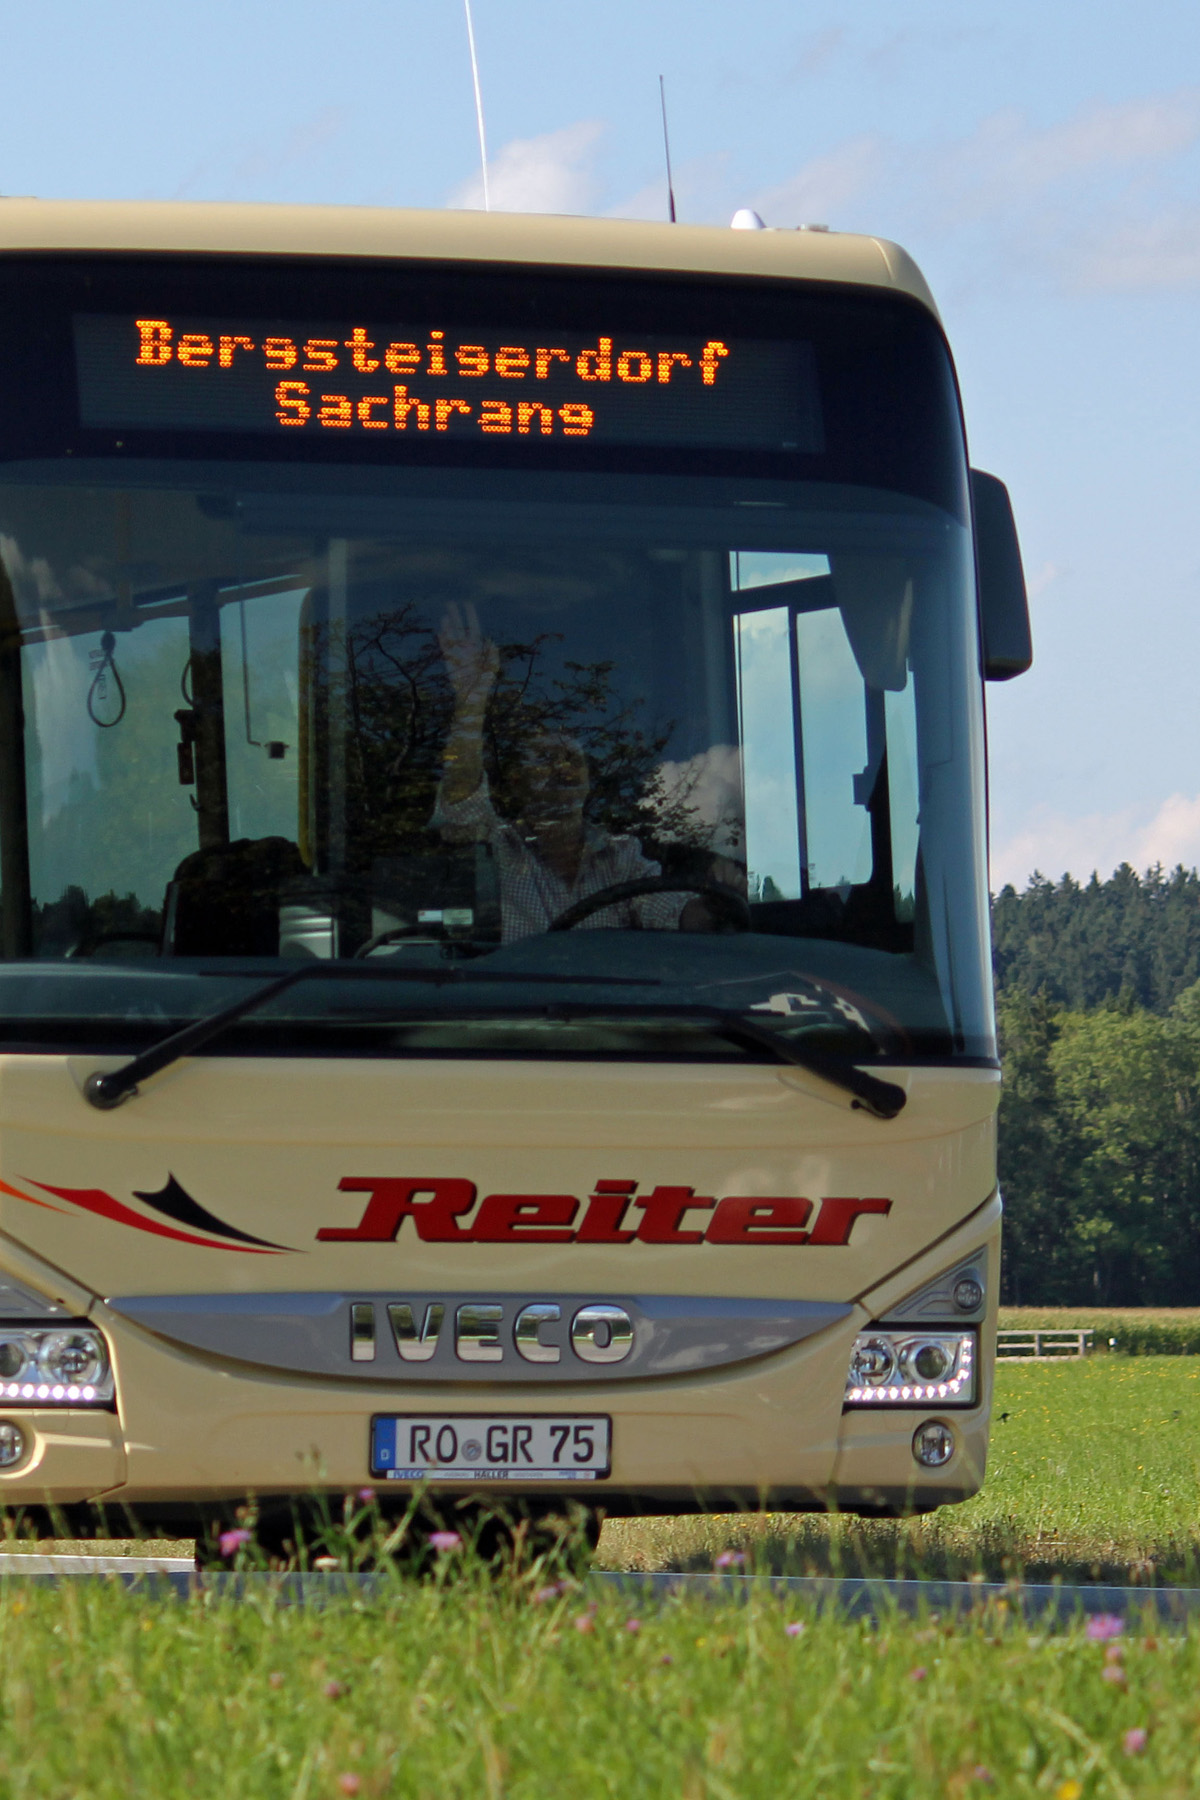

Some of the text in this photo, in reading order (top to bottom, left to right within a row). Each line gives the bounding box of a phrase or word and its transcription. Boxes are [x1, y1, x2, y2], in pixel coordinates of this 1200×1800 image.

[136, 320, 729, 385] Bergsteigerdorf
[275, 382, 594, 435] Sachrang
[315, 1176, 893, 1246] Reiter
[349, 1302, 635, 1364] IVECO
[409, 1424, 458, 1463] RO
[486, 1425, 533, 1463] GR
[550, 1425, 595, 1464] 75
